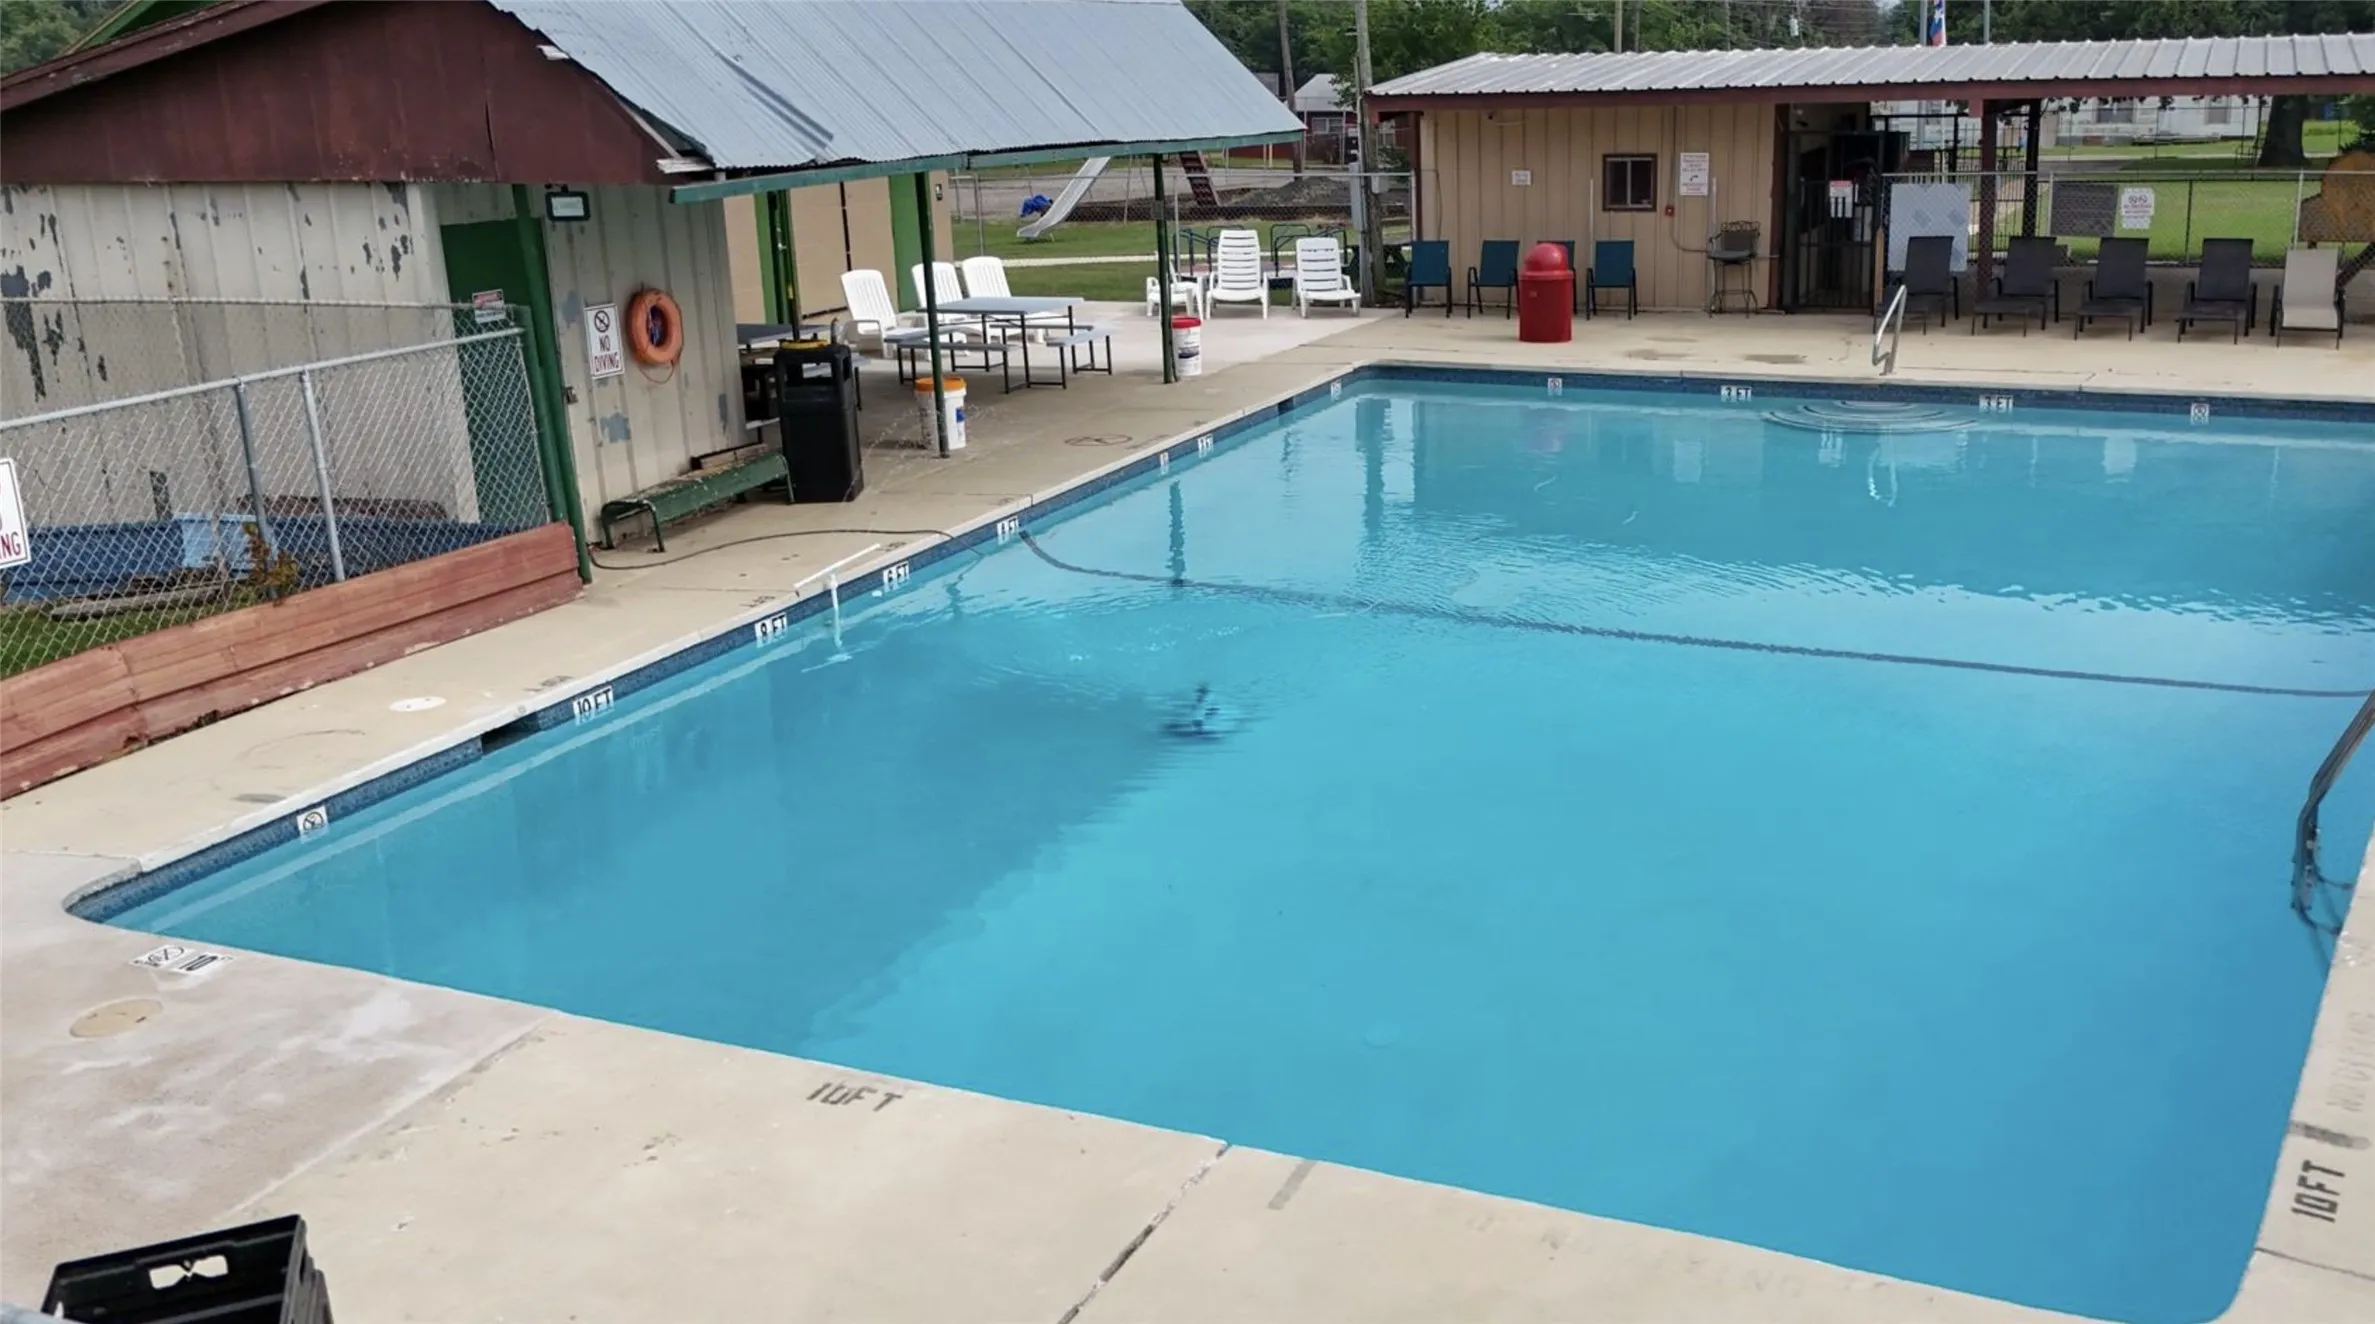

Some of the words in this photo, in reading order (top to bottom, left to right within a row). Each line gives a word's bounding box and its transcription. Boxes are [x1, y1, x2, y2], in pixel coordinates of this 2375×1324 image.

[599, 334, 611, 351] NO
[594, 352, 619, 372] DIVING
[771, 614, 786, 632] FT
[577, 698, 591, 714] 10
[593, 688, 611, 710] FT
[2291, 1160, 2346, 1223] 10FT
